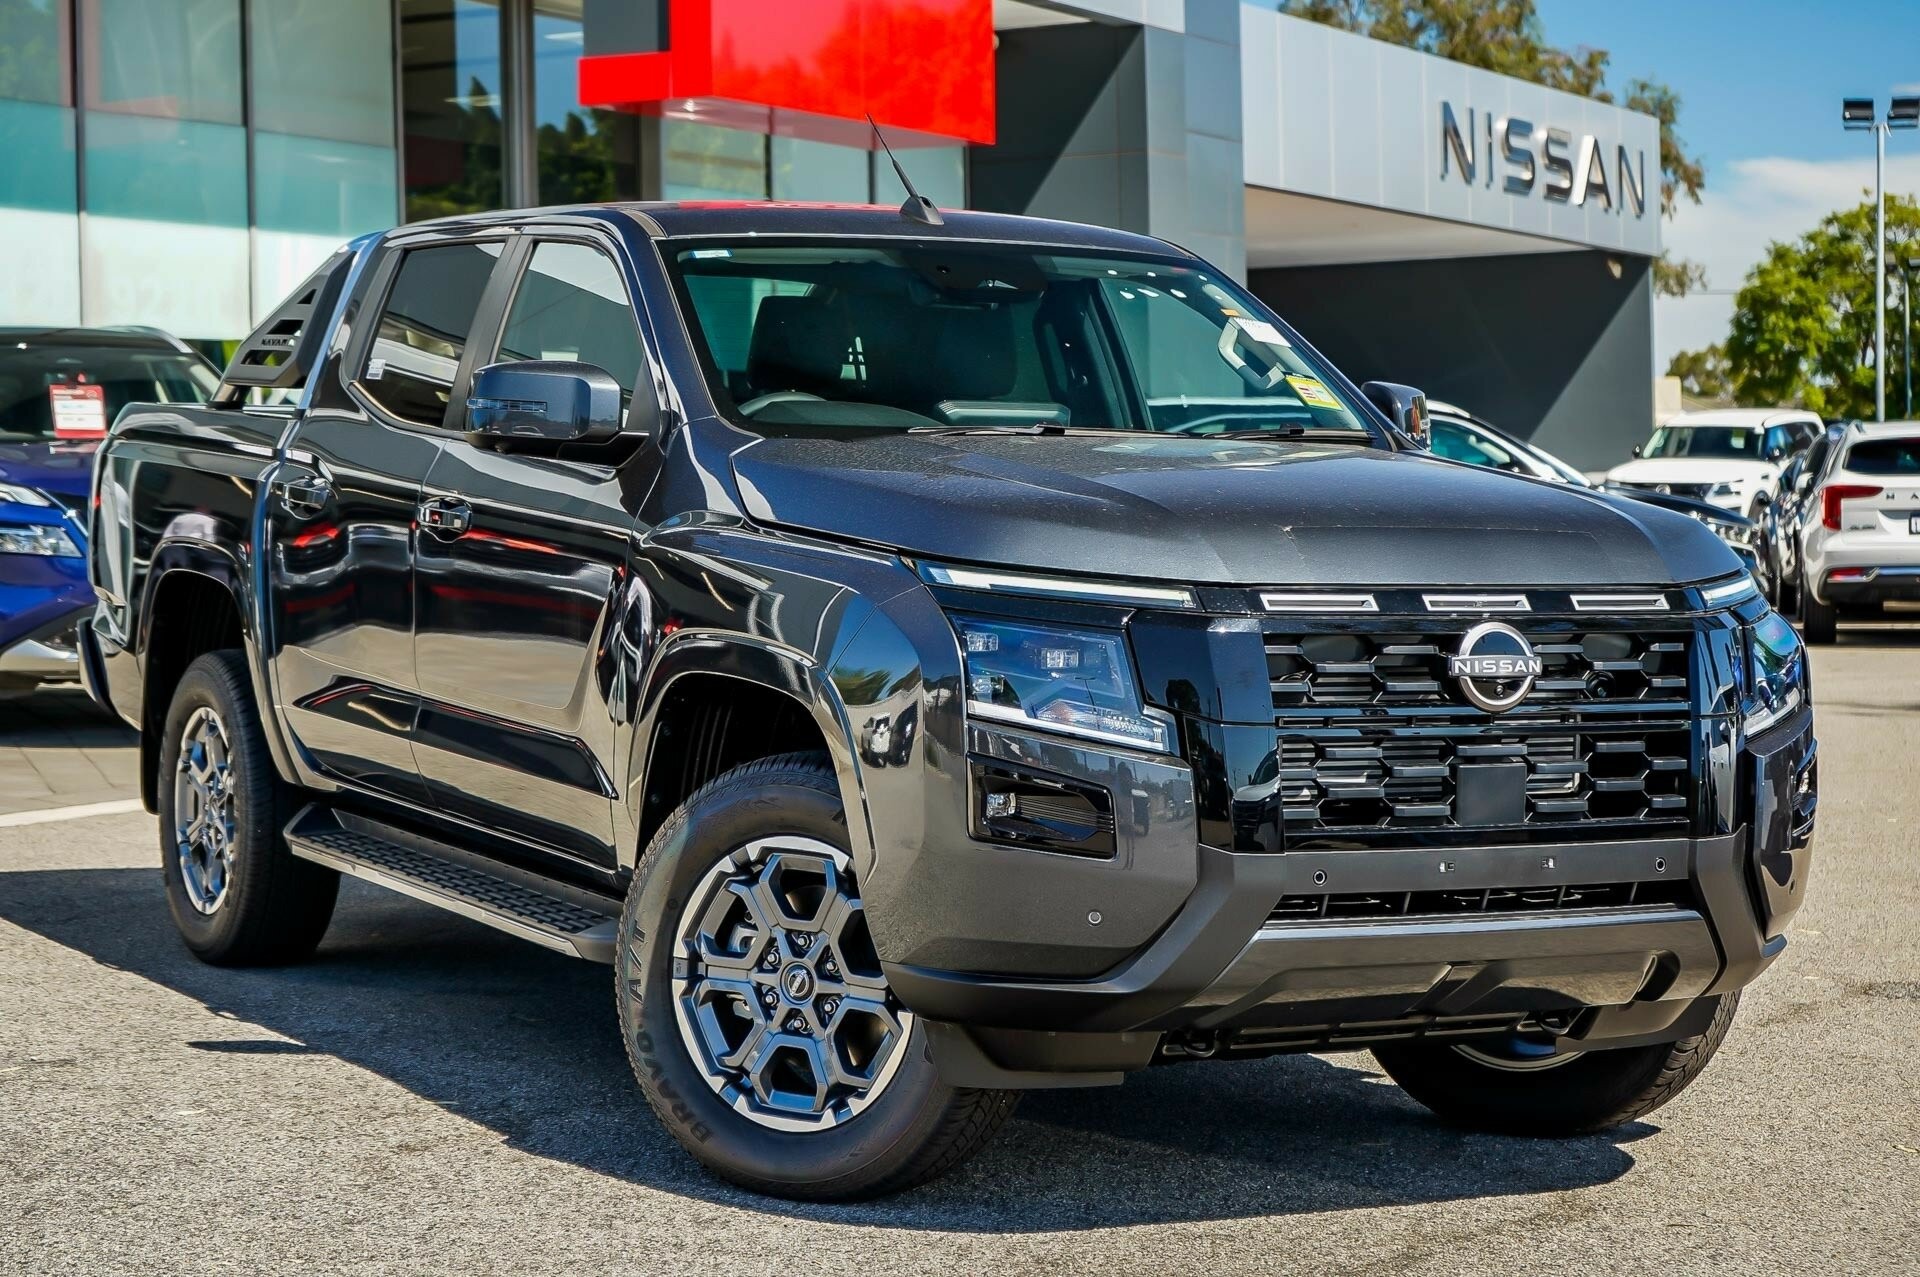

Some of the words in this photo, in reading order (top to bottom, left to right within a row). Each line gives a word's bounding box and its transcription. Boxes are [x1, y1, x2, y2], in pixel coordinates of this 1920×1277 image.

[1440, 101, 1645, 219] NISSAN
[1454, 659, 1541, 674] NISSAN
[635, 1029, 714, 1146] BRAVO
